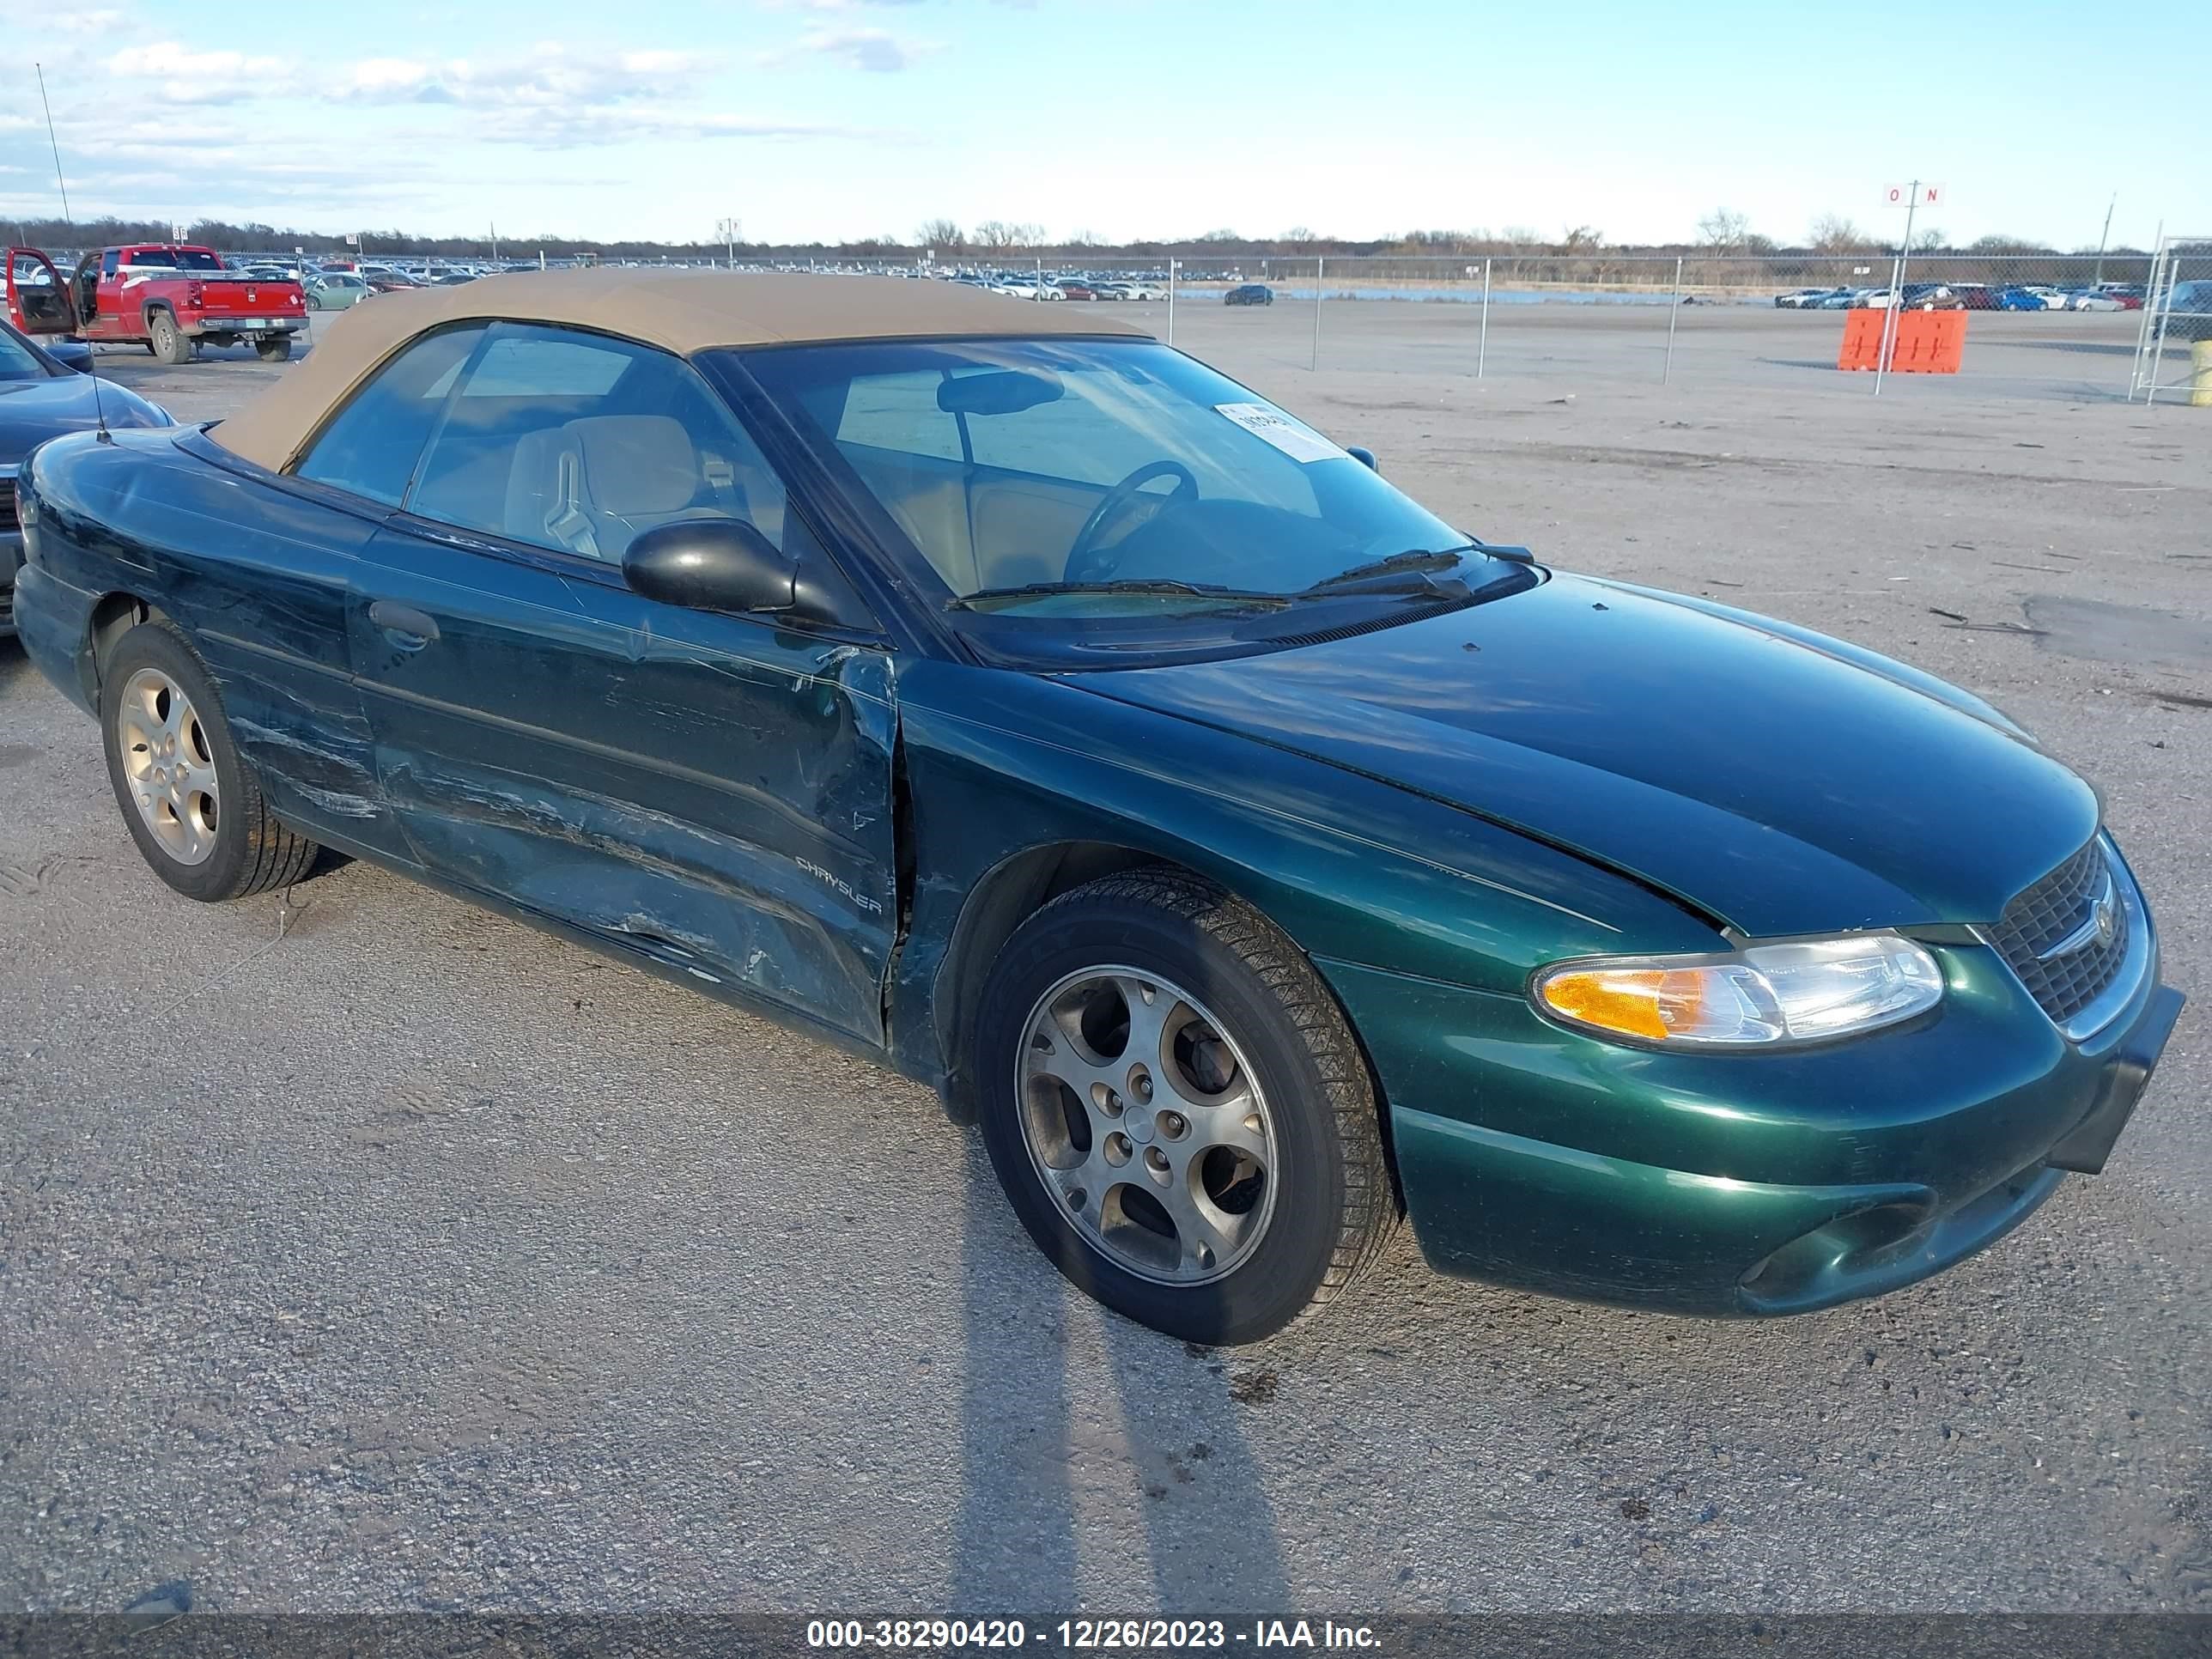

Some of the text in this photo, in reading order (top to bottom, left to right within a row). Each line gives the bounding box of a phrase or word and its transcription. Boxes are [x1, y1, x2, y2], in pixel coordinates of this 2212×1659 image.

[1890, 189, 1899, 202] O
[1927, 189, 1937, 202] N
[794, 855, 882, 915] CHRYSLER
